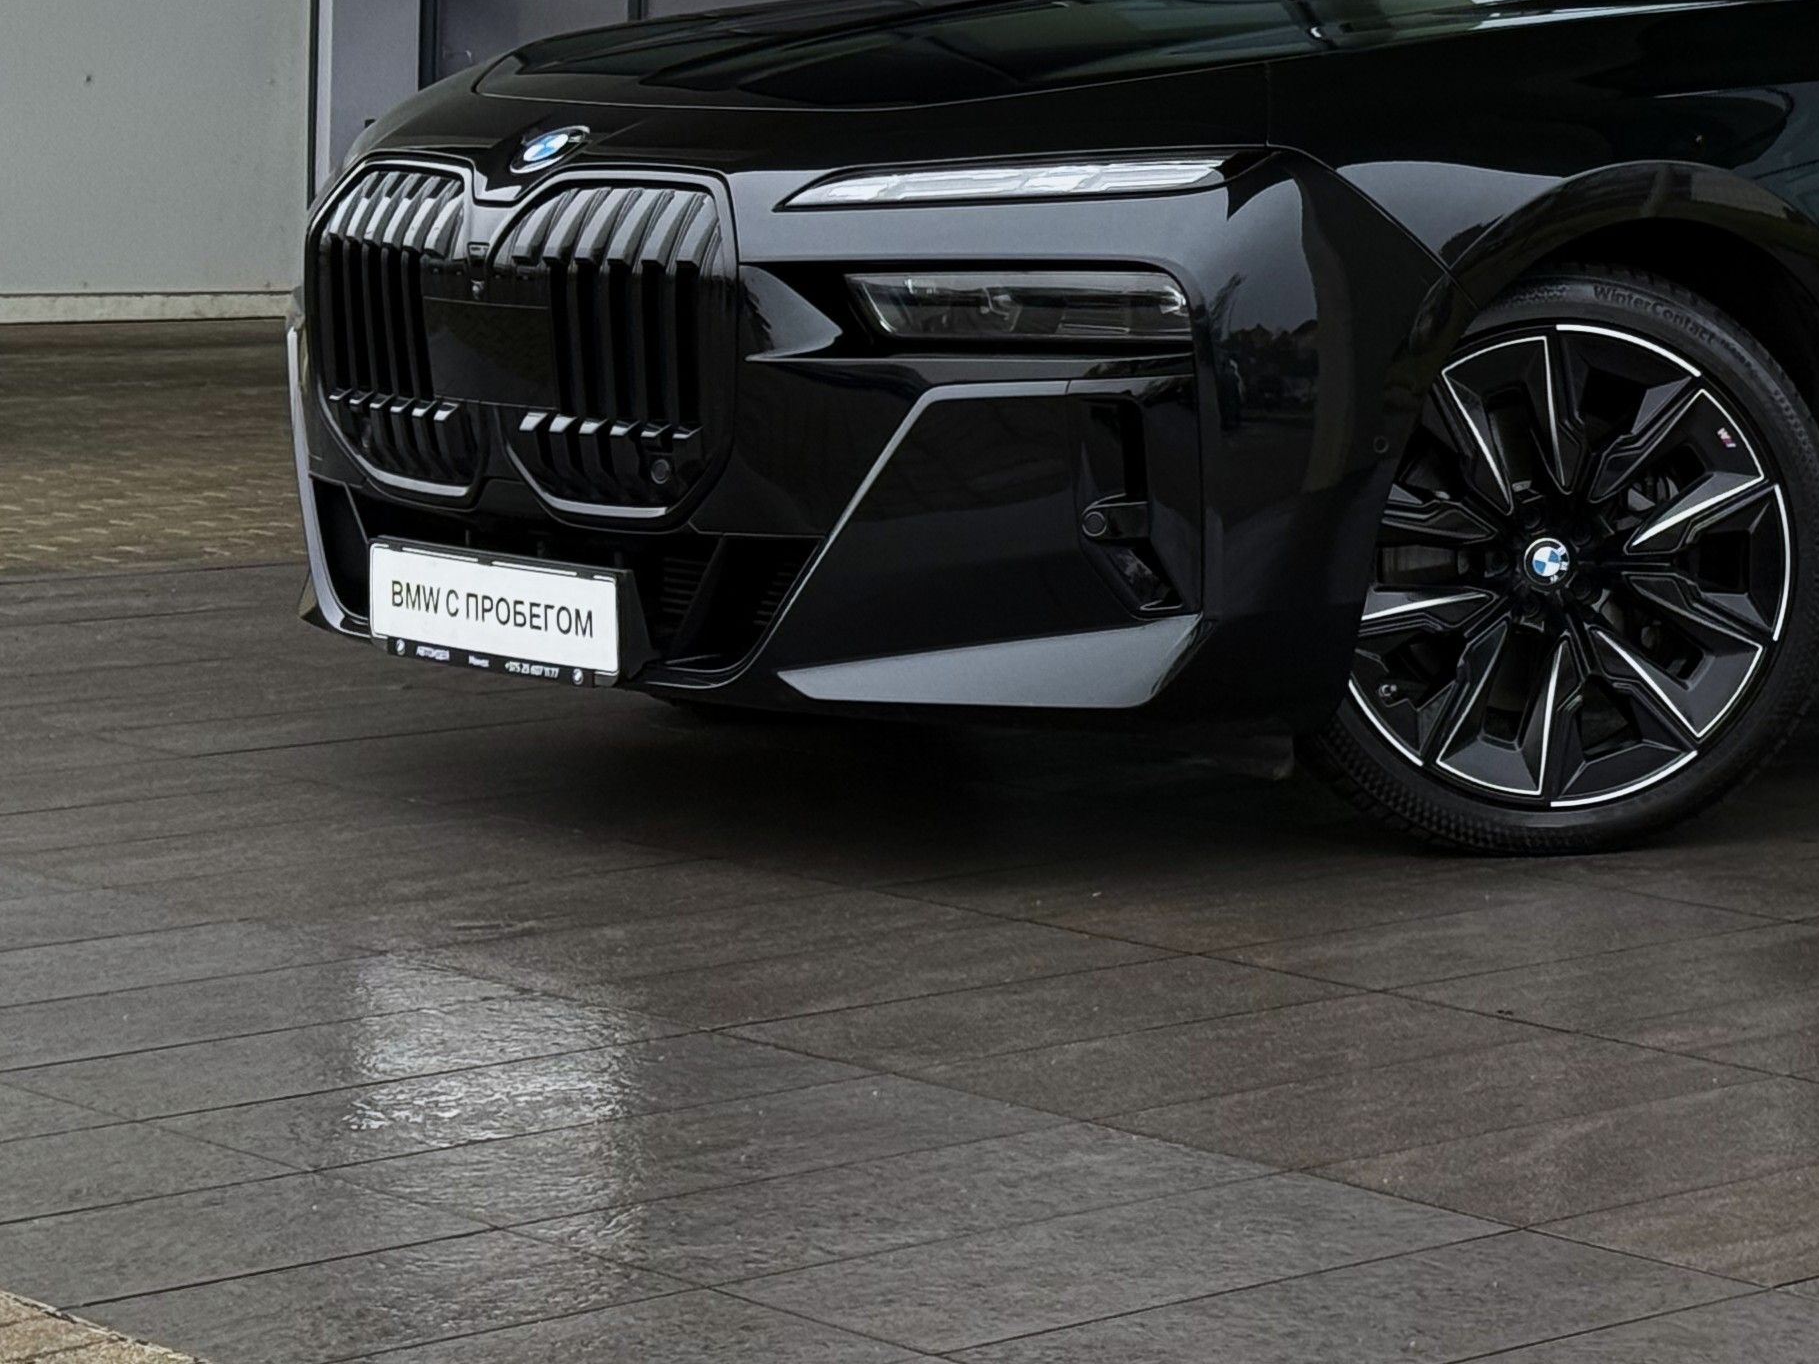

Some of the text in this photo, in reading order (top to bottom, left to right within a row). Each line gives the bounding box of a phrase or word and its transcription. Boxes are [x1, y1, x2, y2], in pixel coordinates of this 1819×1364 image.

[391, 580, 593, 638] BMW С ПРОБЕГОМ
